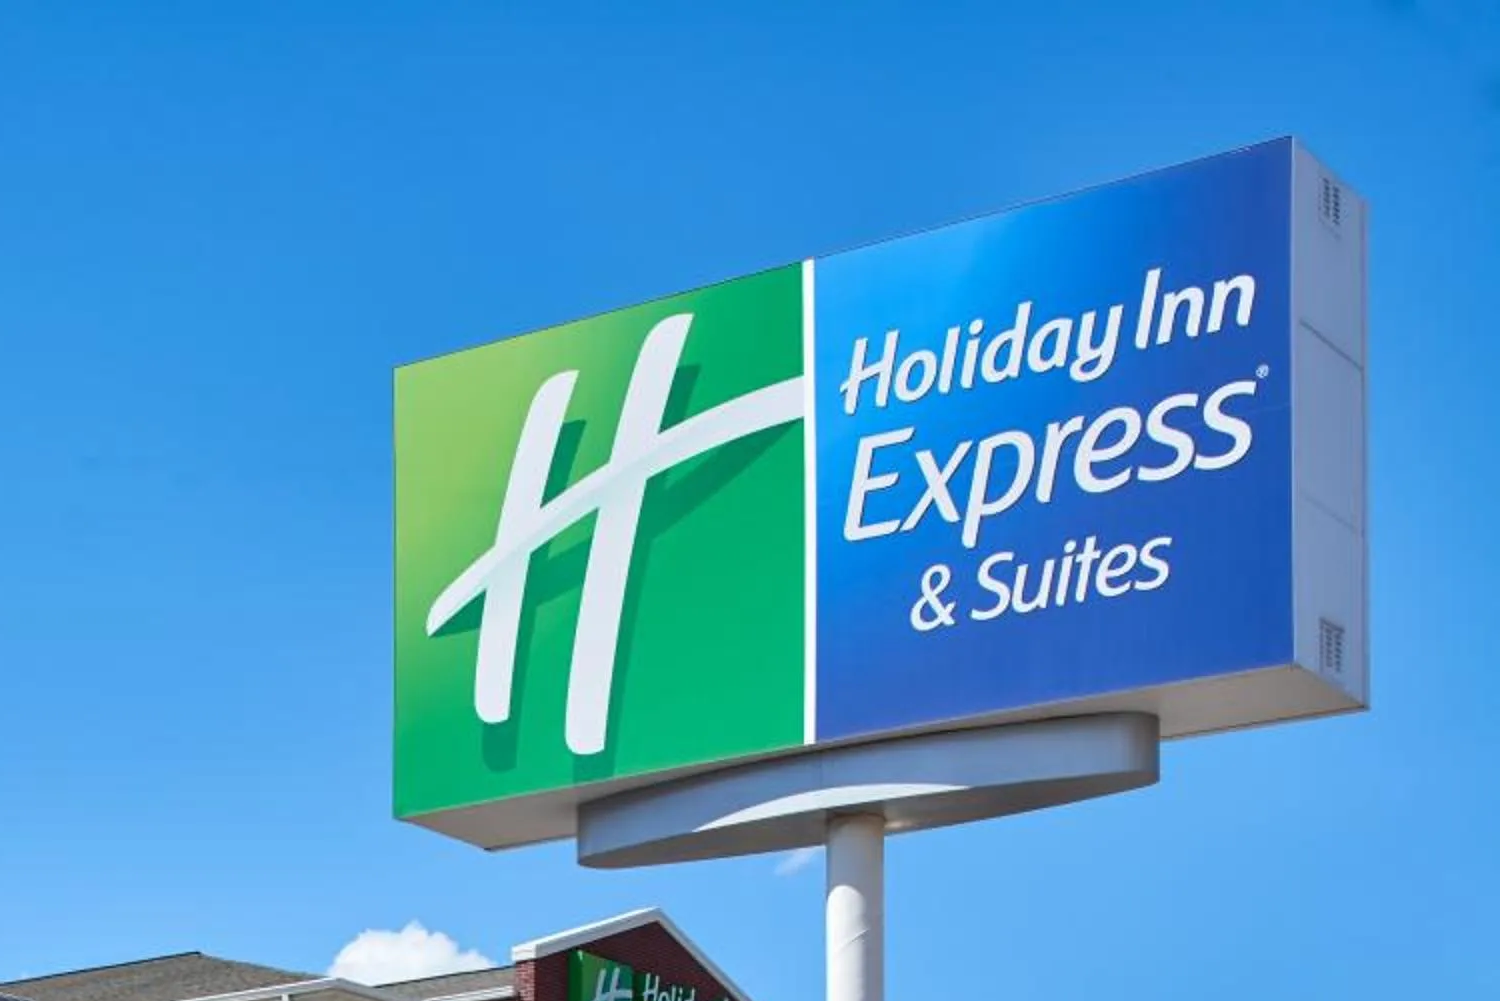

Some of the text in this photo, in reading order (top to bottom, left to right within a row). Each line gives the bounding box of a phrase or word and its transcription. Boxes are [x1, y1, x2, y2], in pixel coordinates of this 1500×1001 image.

[840, 267, 1256, 416] Holiday Inn
[910, 536, 1173, 632] & Suites
